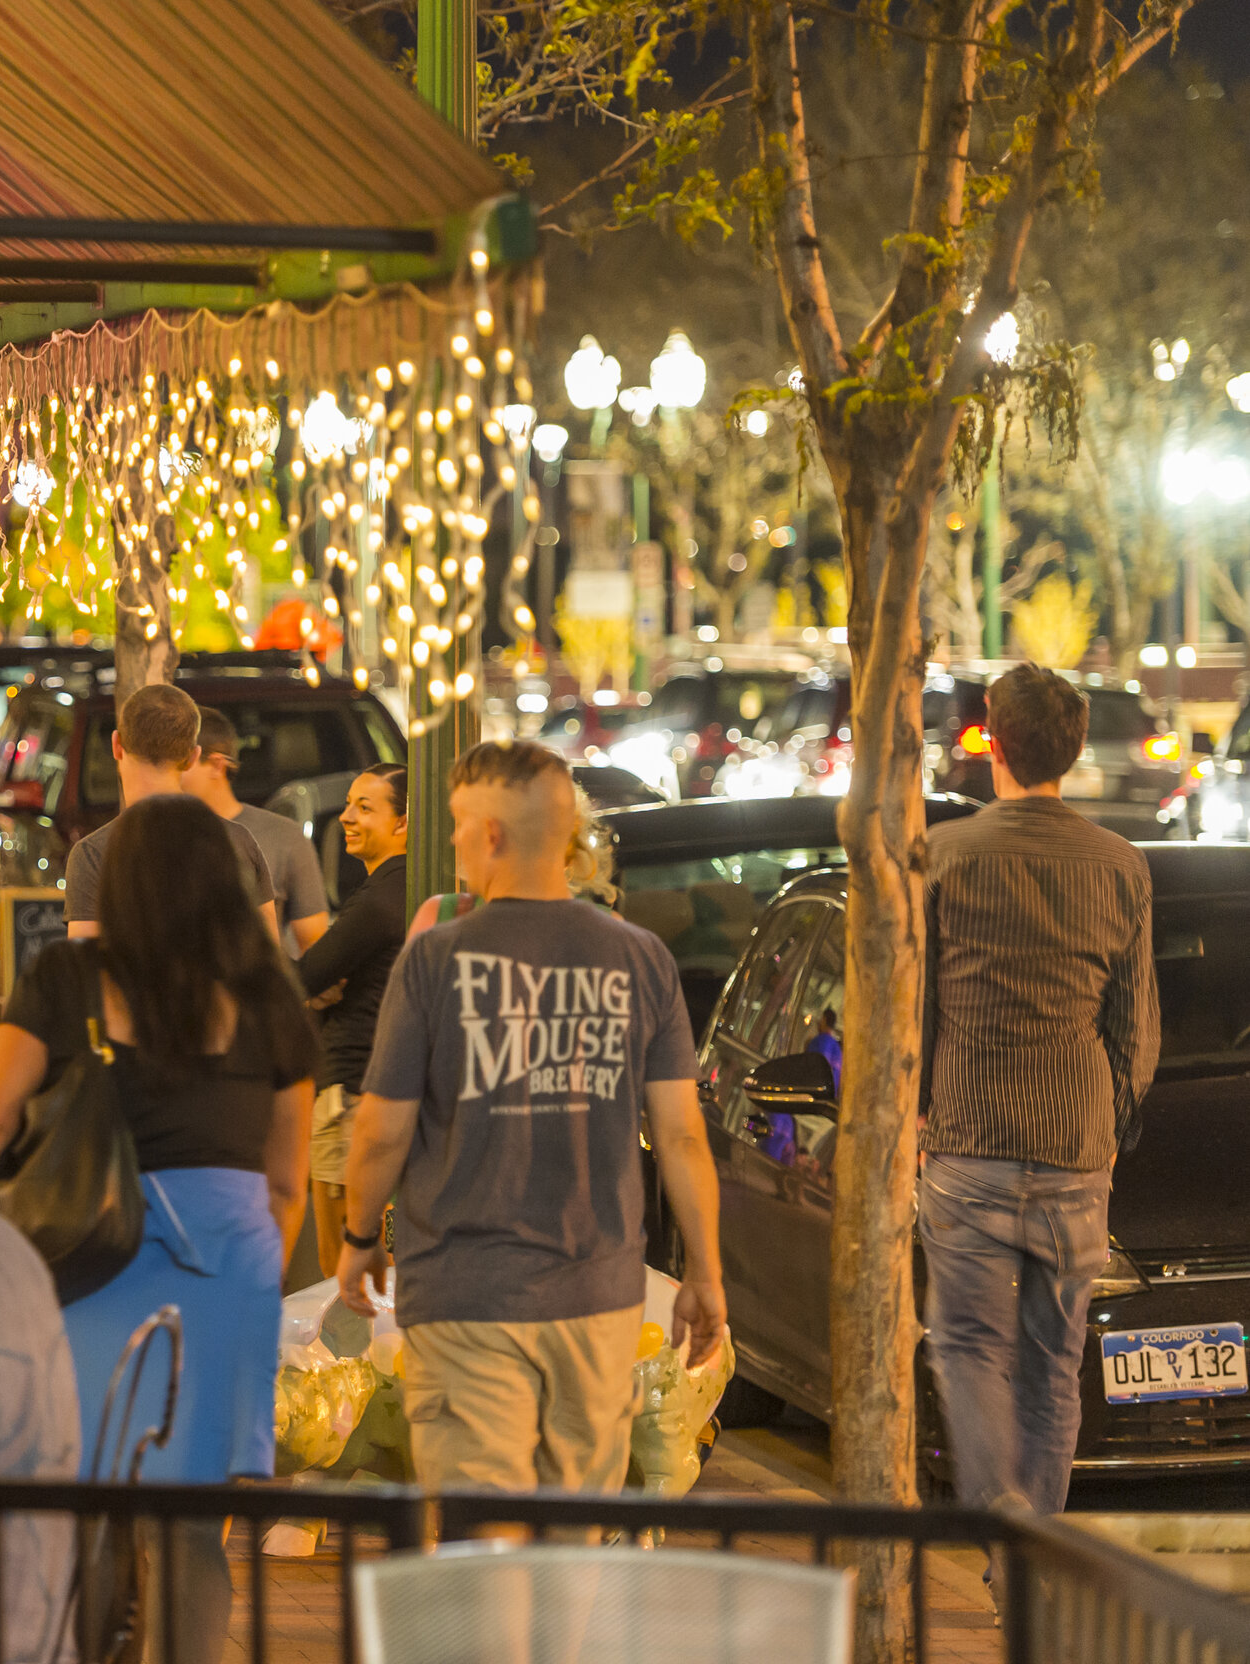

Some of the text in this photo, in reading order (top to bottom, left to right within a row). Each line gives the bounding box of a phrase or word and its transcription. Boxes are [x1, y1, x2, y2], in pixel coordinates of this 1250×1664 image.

[453, 952, 631, 1018] FLYING
[458, 1017, 631, 1102] MOUSE
[529, 1060, 625, 1101] BREWERY
[1141, 1329, 1205, 1344] COLORADO
[1188, 1345, 1238, 1379] 132
